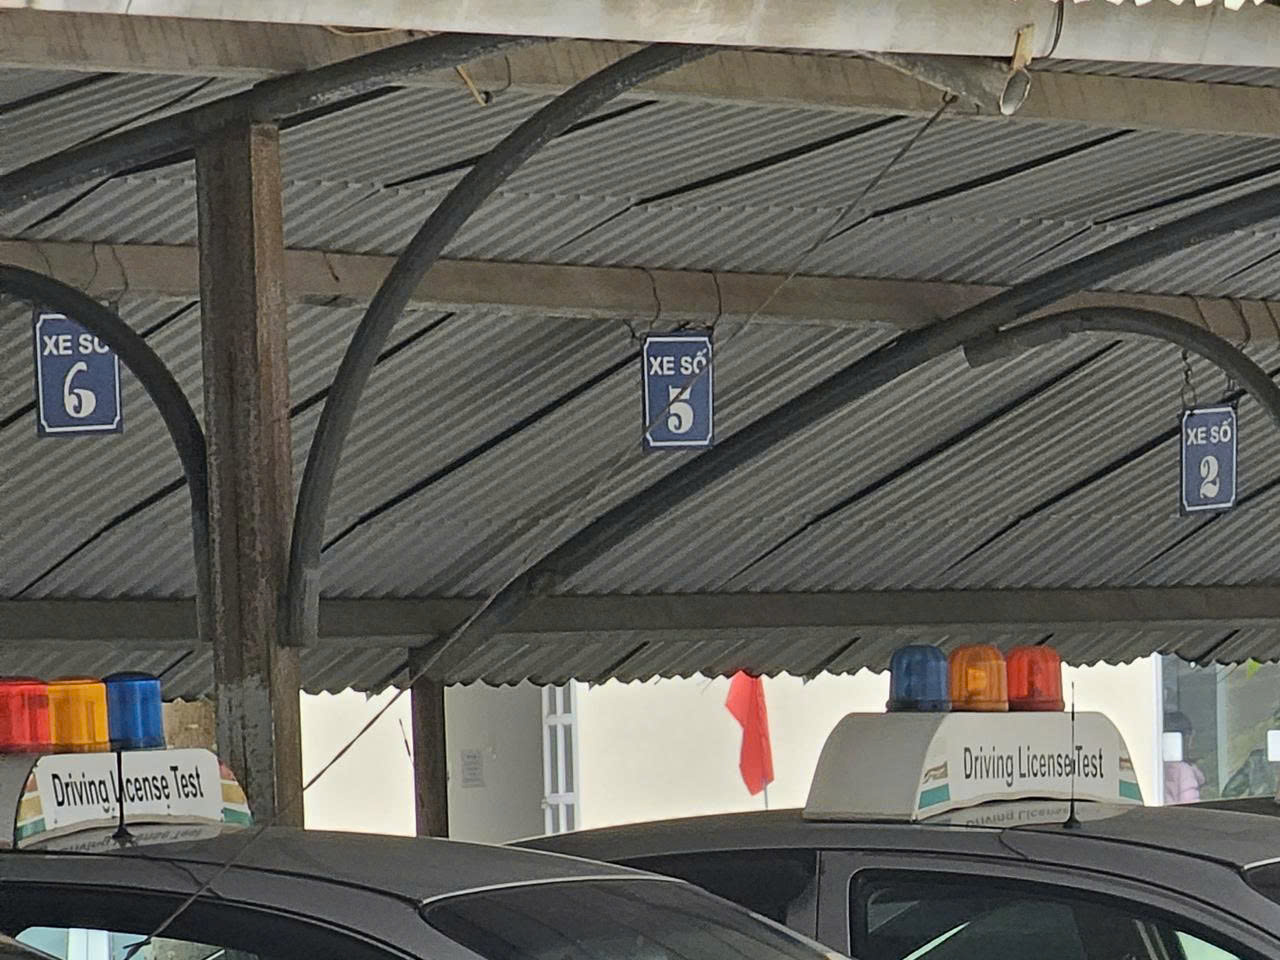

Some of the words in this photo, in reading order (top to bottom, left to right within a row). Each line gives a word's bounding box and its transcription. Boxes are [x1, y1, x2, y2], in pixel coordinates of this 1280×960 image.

[43, 335, 73, 356] XE
[649, 356, 675, 376] XE
[64, 361, 97, 418] 6
[667, 385, 694, 434] 5
[1187, 427, 1207, 446] XE
[1209, 417, 1232, 443] SỐ
[1200, 455, 1220, 499] 2
[963, 746, 1014, 788] Driving
[1018, 746, 1073, 778] License
[1075, 745, 1104, 779] Test
[51, 772, 110, 813] Driving
[169, 765, 204, 799] Test
